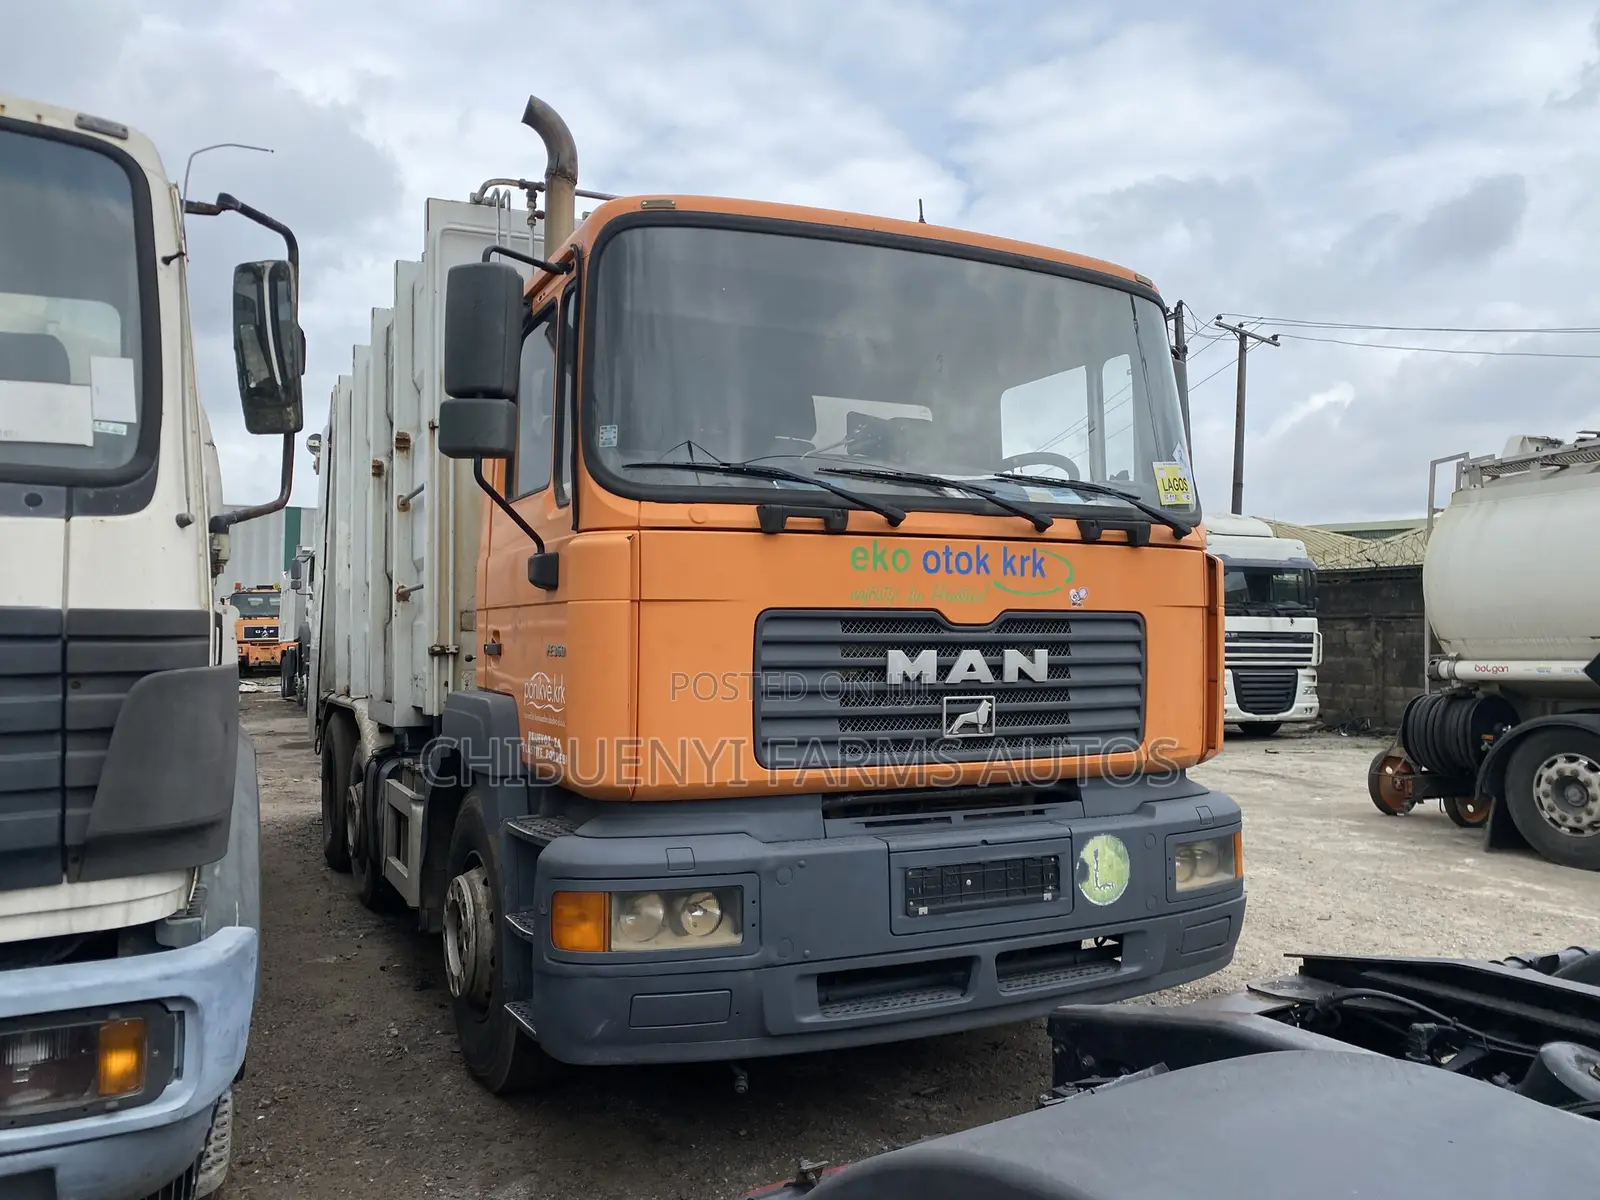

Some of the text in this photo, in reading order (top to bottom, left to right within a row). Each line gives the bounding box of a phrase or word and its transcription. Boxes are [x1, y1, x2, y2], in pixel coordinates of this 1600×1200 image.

[1161, 477, 1188, 492] LAGOS
[850, 540, 1046, 579] eko otok krk
[887, 648, 1050, 685] MAN
